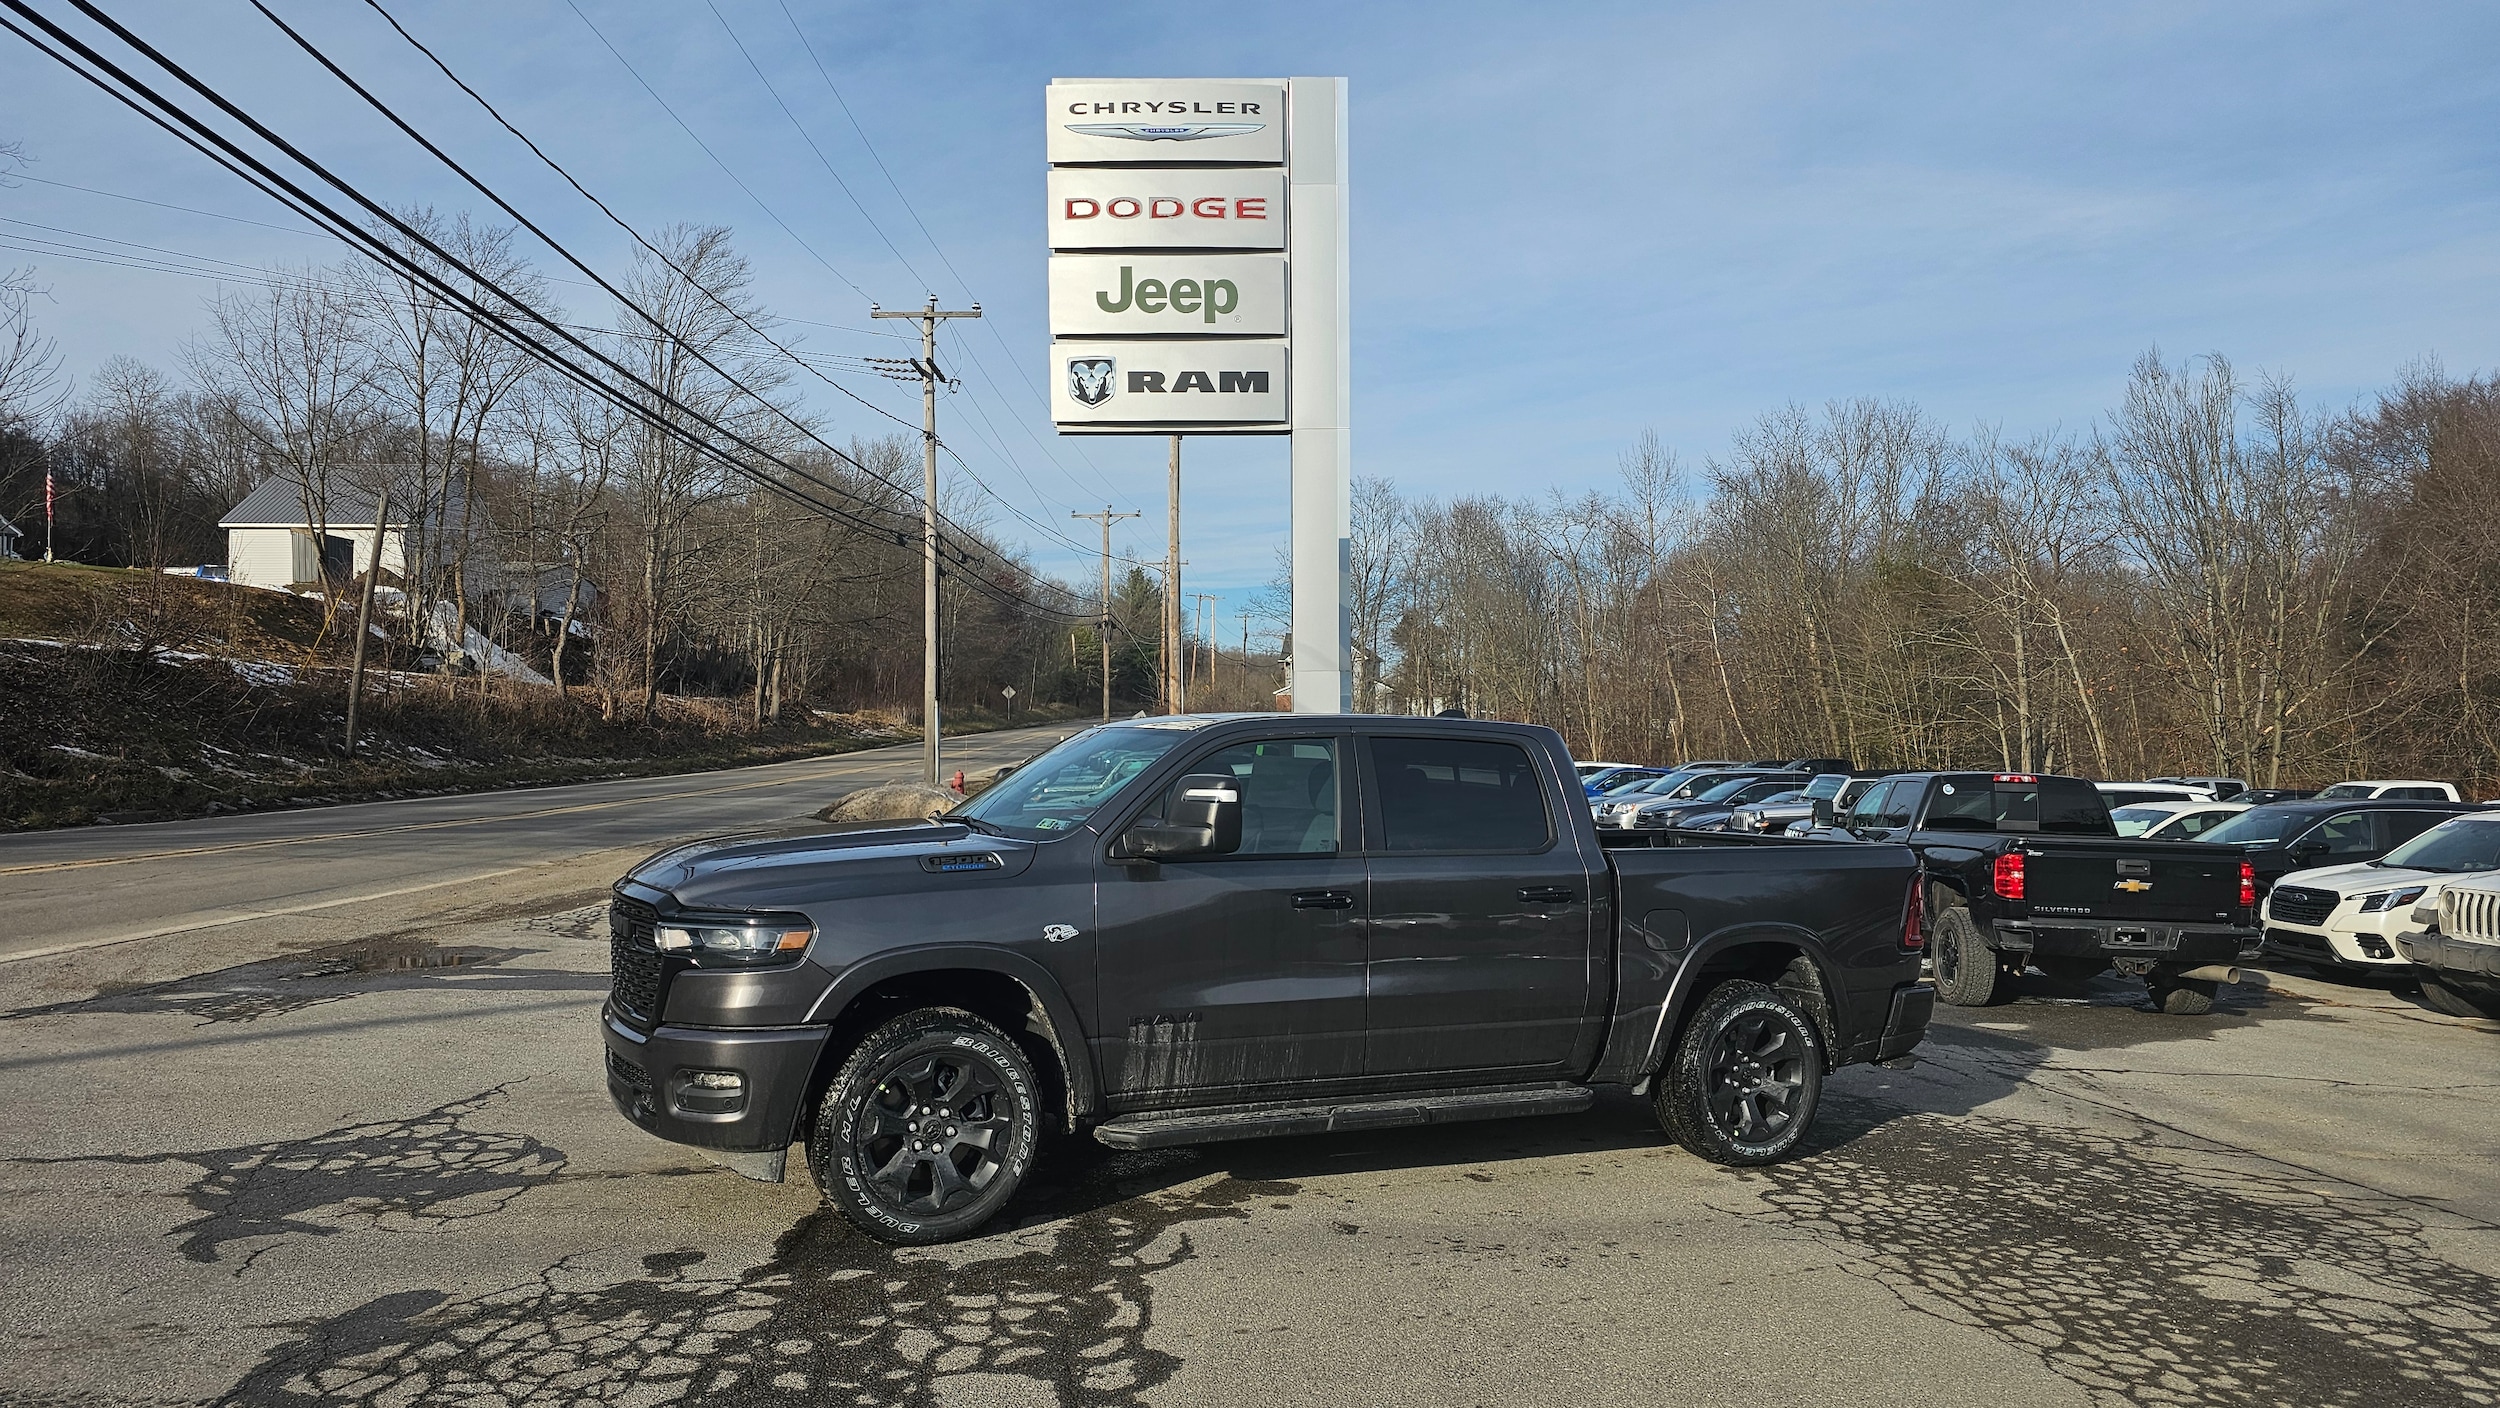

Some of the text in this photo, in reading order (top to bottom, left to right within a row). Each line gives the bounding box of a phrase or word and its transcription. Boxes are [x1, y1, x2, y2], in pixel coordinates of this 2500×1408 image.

[1069, 101, 1261, 115] CHRYSLER
[1065, 197, 1268, 220] DODGE
[1096, 266, 1239, 323] Jeep
[1127, 371, 1269, 393] RAM
[2033, 905, 2091, 914] SILVERADO
[1719, 1001, 1814, 1048] BRIDGESTONE
[952, 1036, 1032, 1176] BRIDGESTONE
[841, 1156, 920, 1233] DUELER
